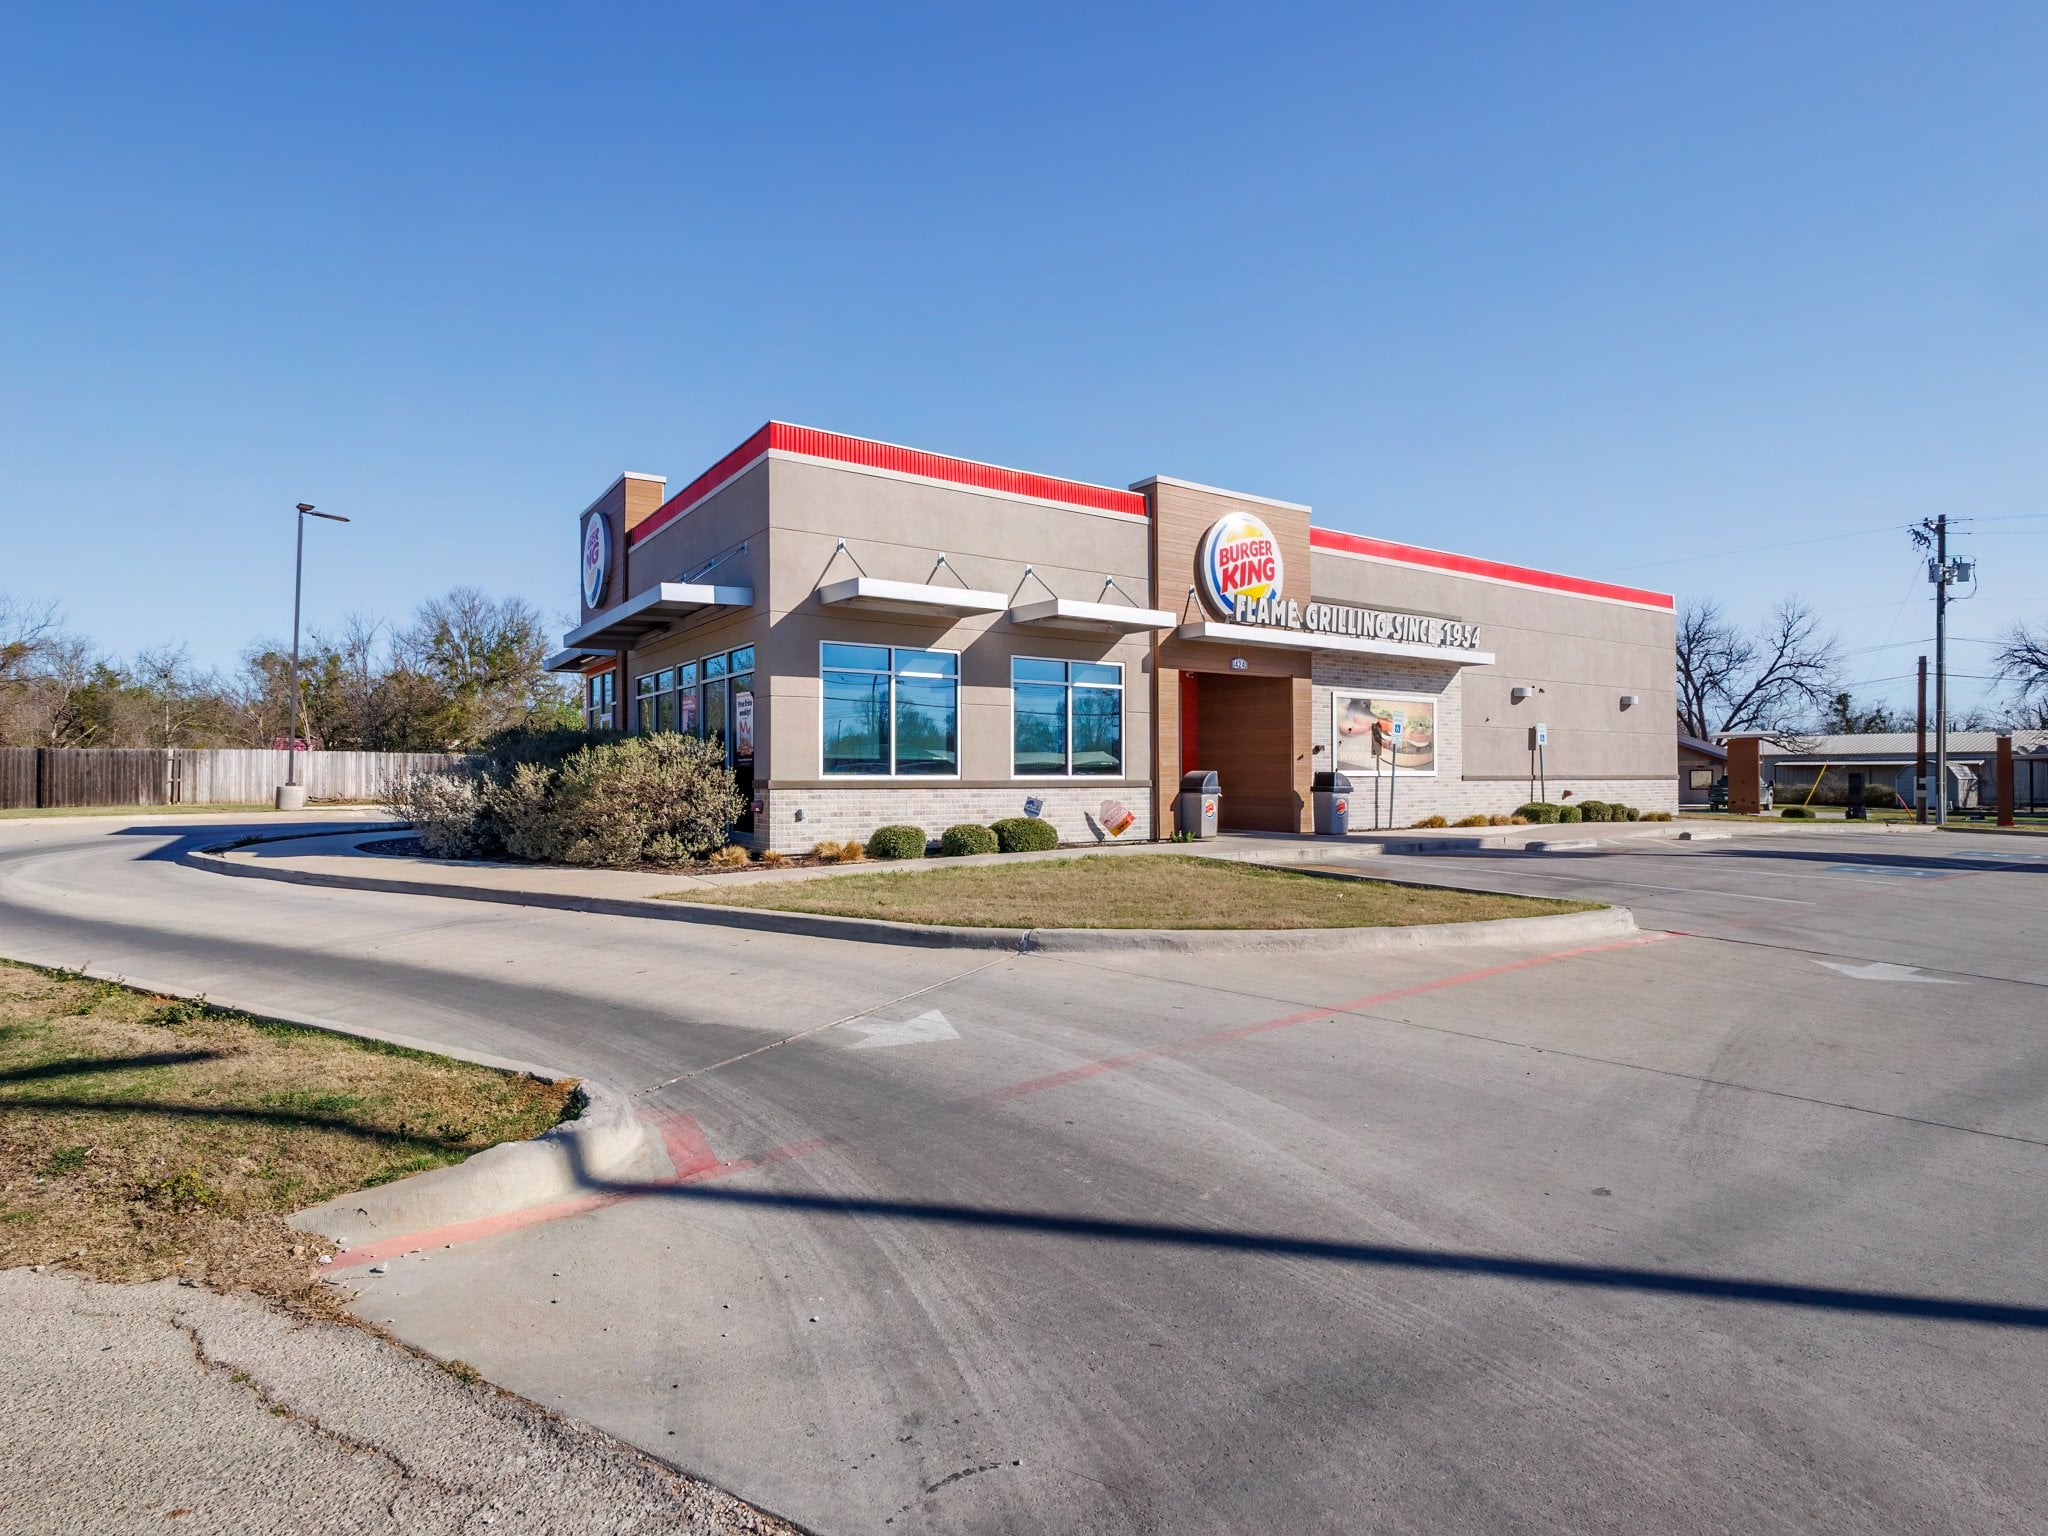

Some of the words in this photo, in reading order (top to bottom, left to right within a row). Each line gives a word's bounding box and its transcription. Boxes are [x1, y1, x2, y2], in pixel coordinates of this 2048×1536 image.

[1219, 540, 1273, 568] BURGER
[1220, 557, 1275, 595] KING
[1235, 594, 1301, 629] FLAME
[1306, 605, 1387, 638] GRILLING
[1394, 615, 1438, 645] SINCE
[1444, 623, 1481, 649] 1954
